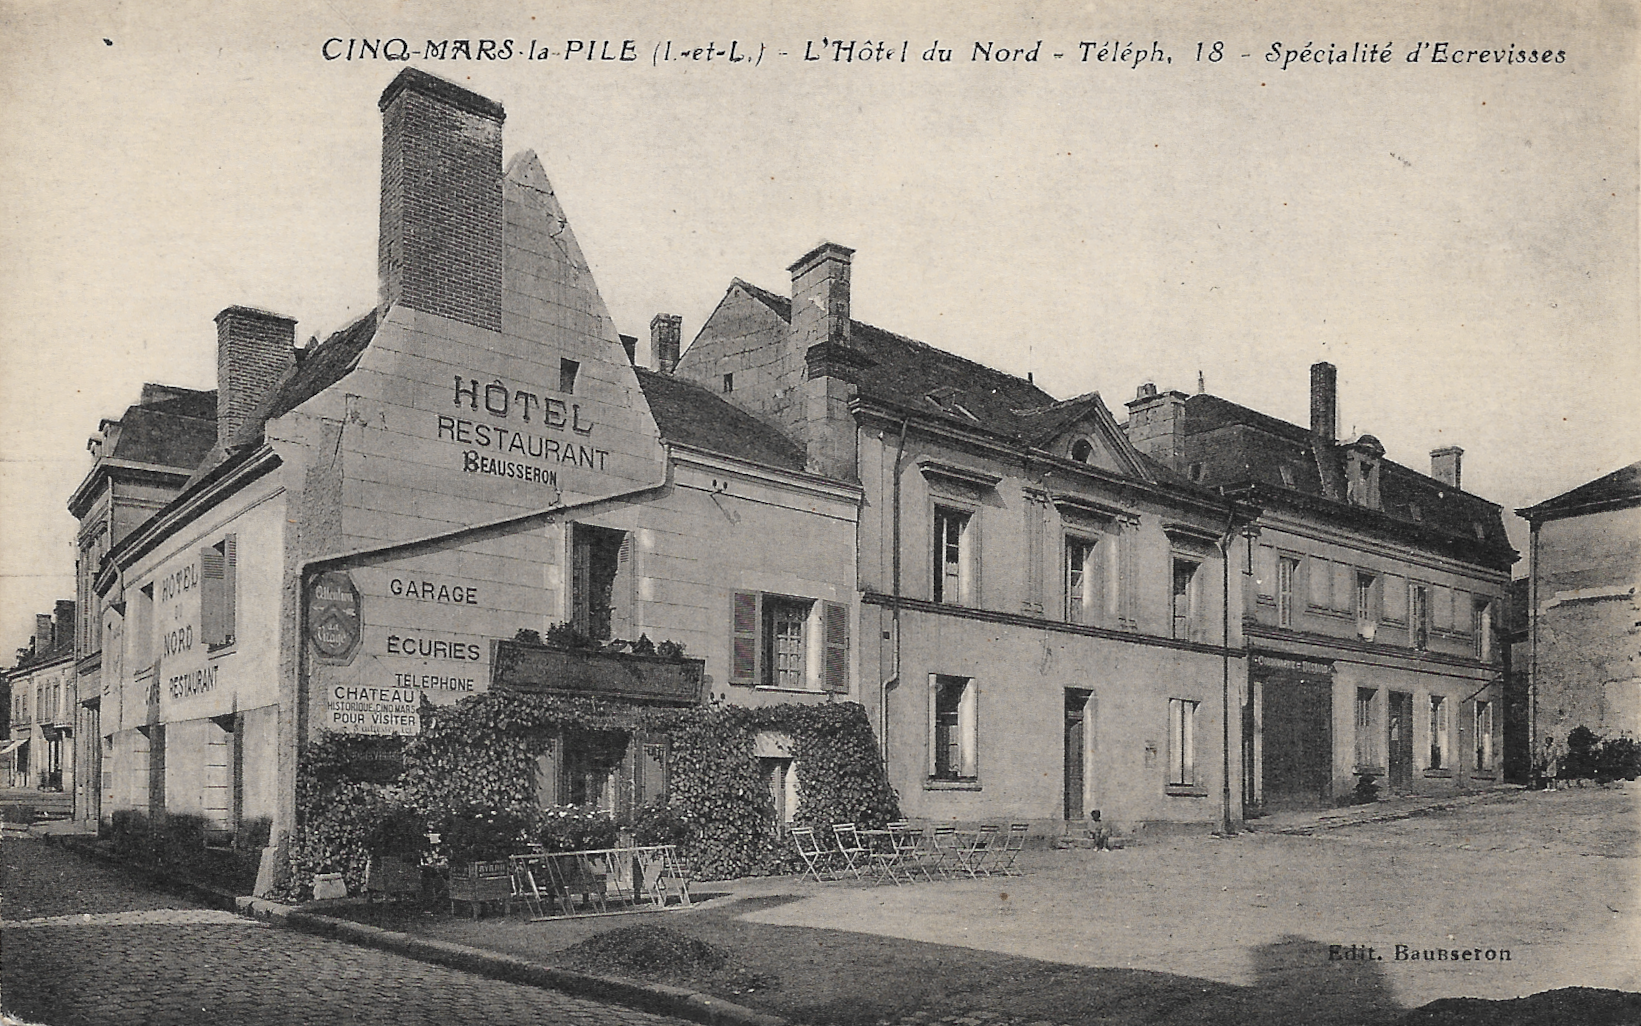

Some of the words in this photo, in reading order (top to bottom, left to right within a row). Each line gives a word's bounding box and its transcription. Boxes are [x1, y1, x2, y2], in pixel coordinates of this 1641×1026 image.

[453, 375, 594, 437] HÔTEL
[438, 415, 609, 471] RESTAURANT
[390, 578, 478, 605] GARAGE
[163, 624, 193, 658] NORD
[168, 664, 219, 699] RESTAURANT
[334, 686, 415, 704] CHATEAU
[333, 712, 366, 724] POUR
[371, 713, 416, 727] VISITER
[394, 704, 416, 715] MARS
